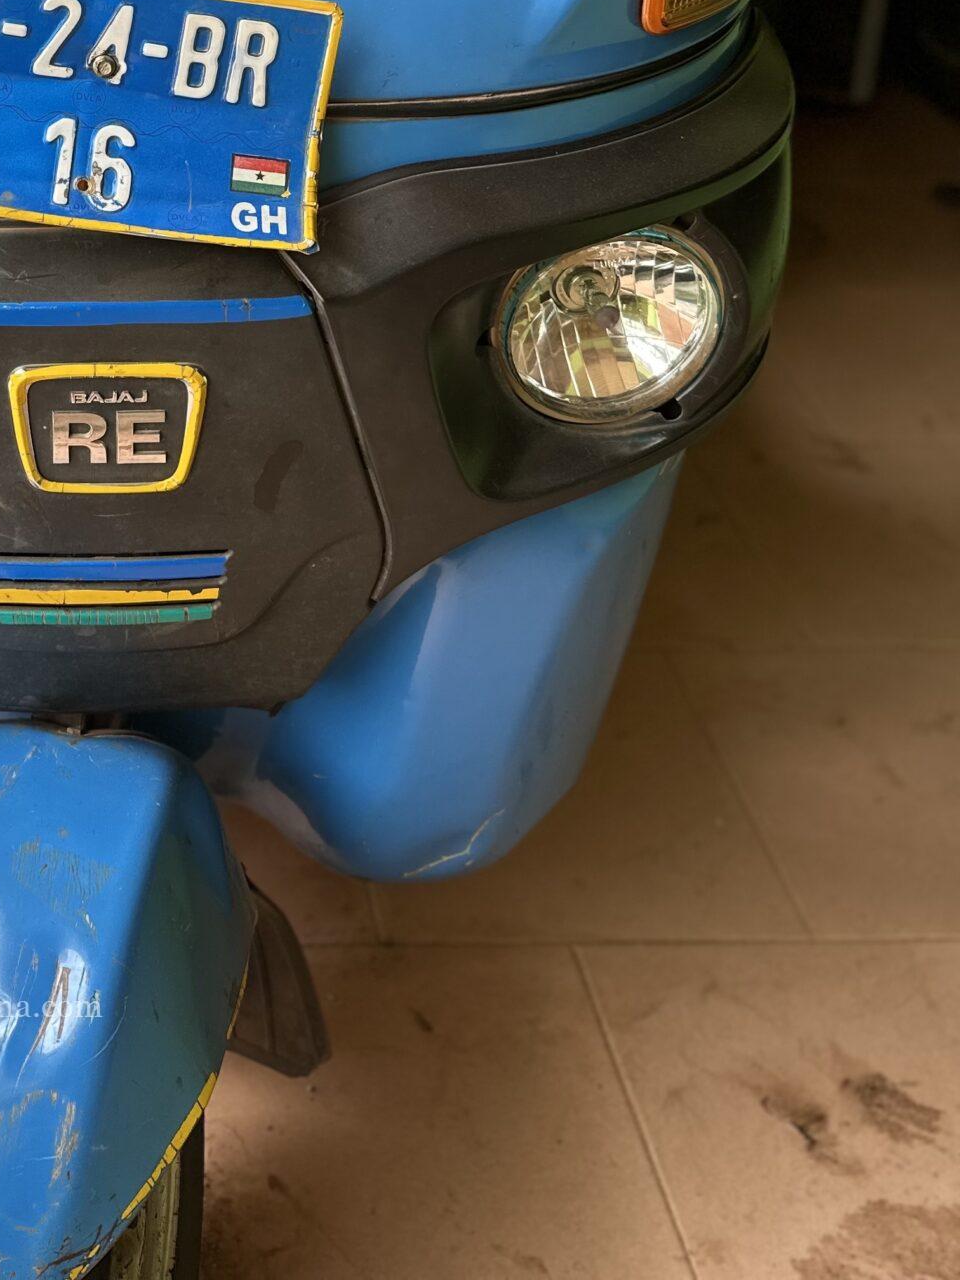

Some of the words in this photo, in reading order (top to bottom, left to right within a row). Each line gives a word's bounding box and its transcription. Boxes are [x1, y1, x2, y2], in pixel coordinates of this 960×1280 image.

[44, 117, 136, 212] 16
[230, 201, 288, 235] GH
[70, 389, 148, 404] BAJAJ
[52, 409, 167, 464] RE
